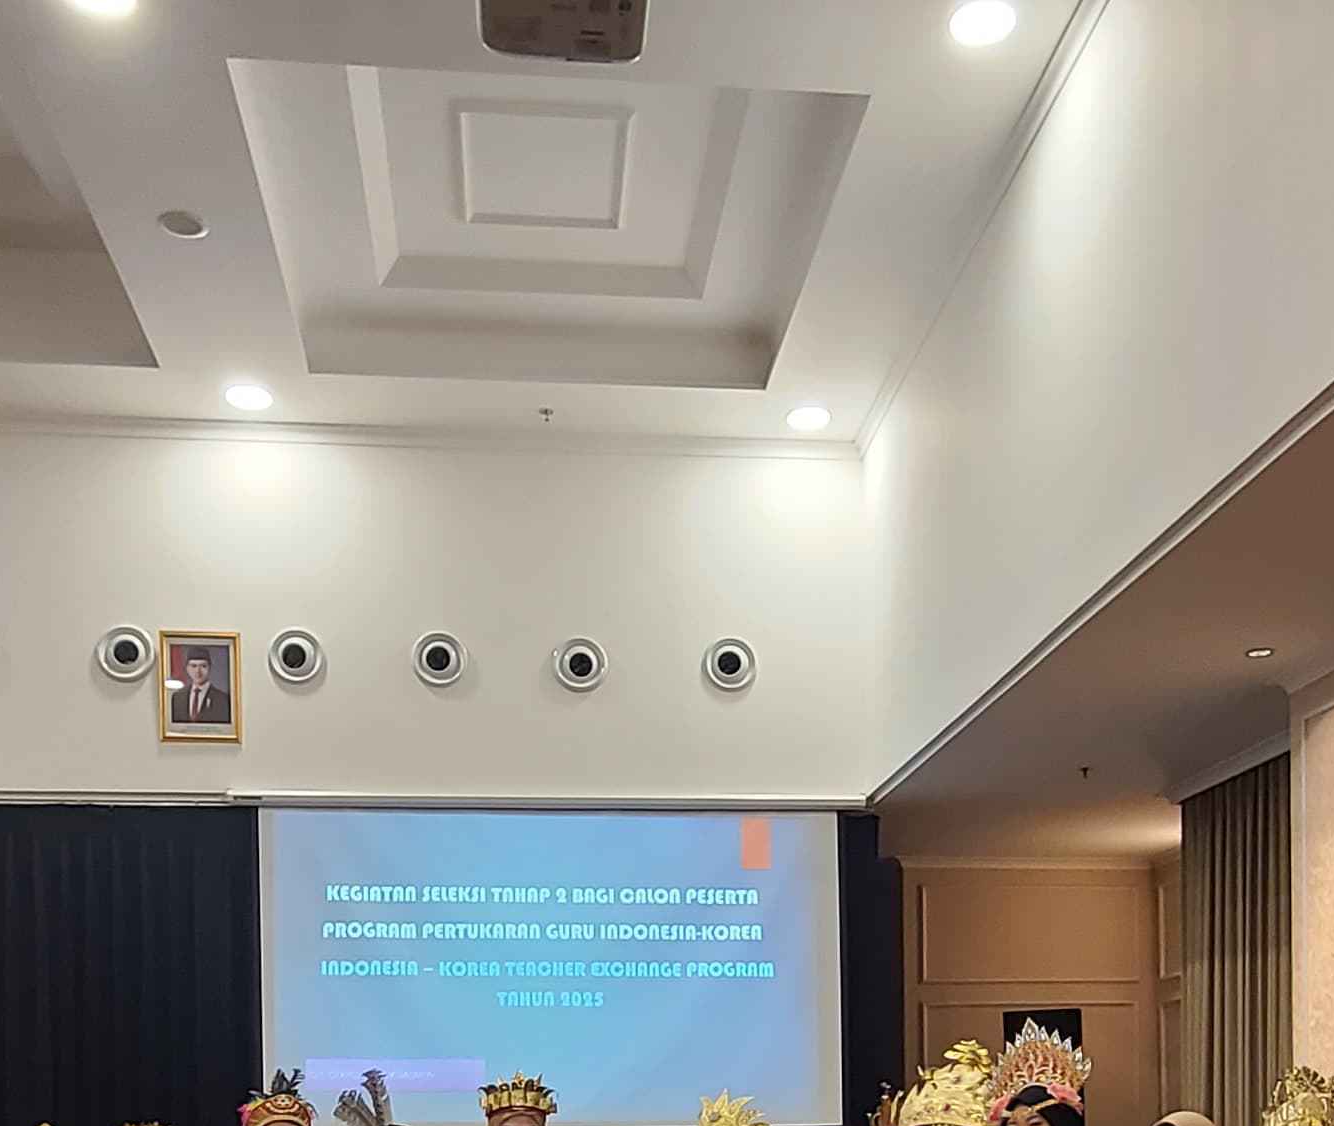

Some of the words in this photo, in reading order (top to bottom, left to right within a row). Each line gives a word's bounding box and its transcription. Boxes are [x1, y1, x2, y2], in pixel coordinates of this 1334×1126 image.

[326, 884, 417, 902] KEGIATAN
[421, 885, 486, 903] SELEKSI
[490, 886, 551, 904] TAHAP
[556, 887, 568, 904] 2
[572, 887, 615, 905] BAGI
[619, 887, 681, 905] CALON
[685, 888, 759, 905] PESERTA
[322, 922, 417, 939] PROGRAM
[422, 923, 541, 940] PERTUKARAN
[546, 923, 595, 941] GURU
[600, 924, 763, 941] INDONESIA-KOREA
[321, 959, 419, 977] INDONESIA
[439, 961, 501, 977] KOREA
[504, 961, 586, 978] TEACHER
[590, 961, 682, 978] EXCHANGE
[686, 961, 775, 978] PROGRAM
[496, 991, 555, 1008] TAHUN
[560, 991, 604, 1008] 2025
